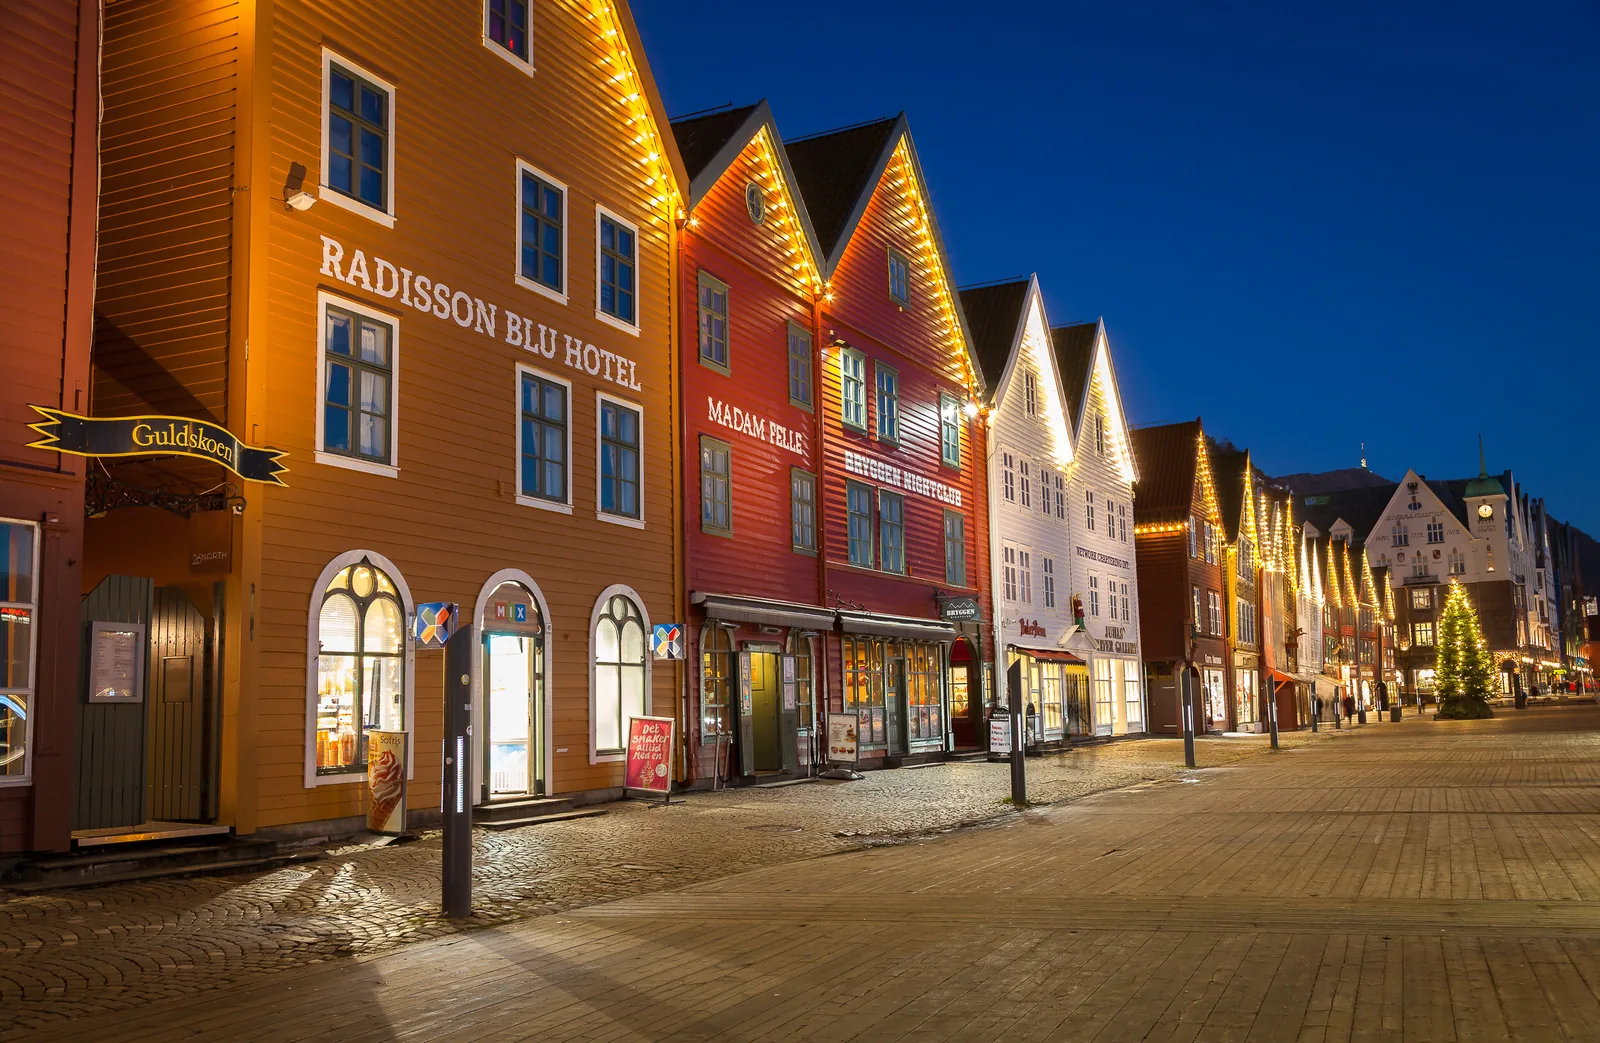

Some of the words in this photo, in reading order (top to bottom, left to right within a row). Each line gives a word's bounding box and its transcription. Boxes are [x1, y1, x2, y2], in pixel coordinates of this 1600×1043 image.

[319, 235, 497, 338] RADISSON
[504, 309, 558, 359] BLU
[563, 333, 641, 392] HOTEL
[707, 396, 766, 440] MADAM
[769, 421, 803, 455] FELLE
[132, 423, 233, 462] Guldskoen
[844, 450, 901, 487] BRYGGEN
[903, 470, 962, 507] NIGHTCLUB
[497, 605, 525, 619] MIX
[380, 735, 402, 744] Softis
[643, 724, 660, 734] Det
[636, 744, 661, 752] alltid
